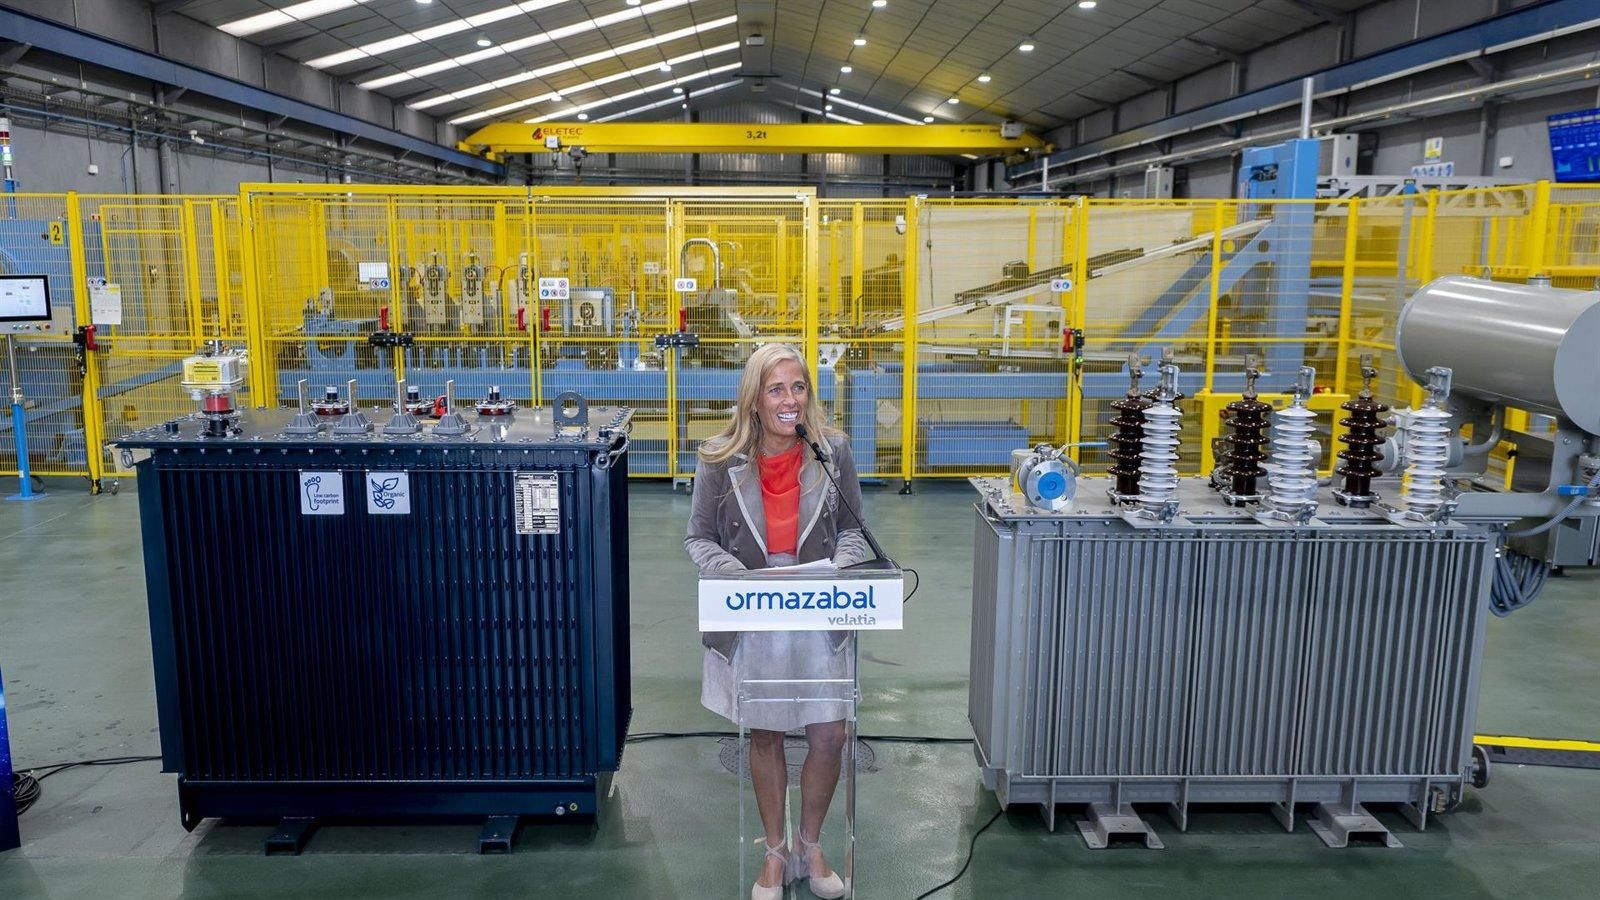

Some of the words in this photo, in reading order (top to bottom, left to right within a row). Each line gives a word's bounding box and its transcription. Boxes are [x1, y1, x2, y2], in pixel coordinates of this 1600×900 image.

[543, 127, 584, 136] ELETEC
[746, 130, 767, 140] 3,2t
[52, 224, 60, 241] 2
[726, 585, 876, 610] ormazabal
[828, 613, 876, 626] velatia
